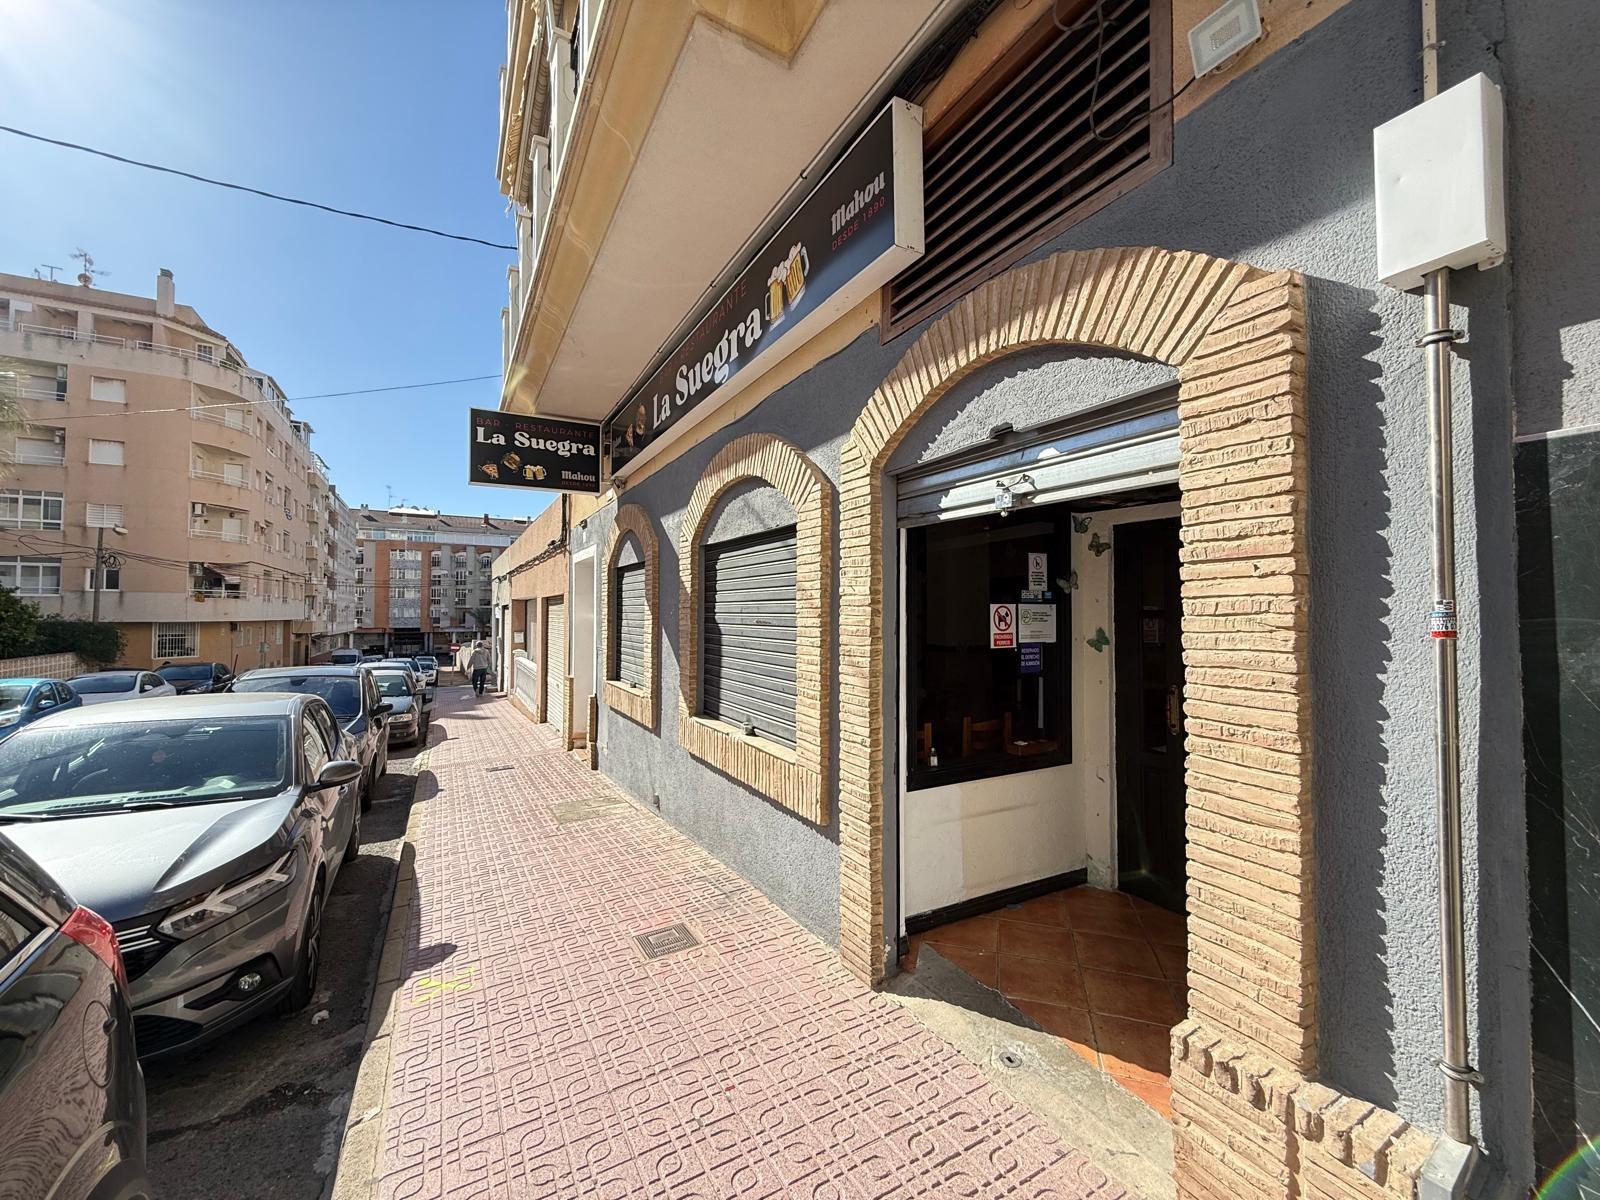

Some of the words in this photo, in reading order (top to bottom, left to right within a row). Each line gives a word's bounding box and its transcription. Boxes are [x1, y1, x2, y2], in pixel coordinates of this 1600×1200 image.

[831, 171, 886, 236] Mahou
[832, 220, 859, 251] DESDE
[863, 196, 885, 222] 1890
[652, 391, 671, 429] La
[675, 307, 763, 407] Suegra
[476, 417, 502, 428] BAR
[515, 422, 595, 440] RESTAURANTE
[476, 426, 506, 446] La
[513, 430, 597, 458] Suegra
[561, 470, 596, 483] Mahou
